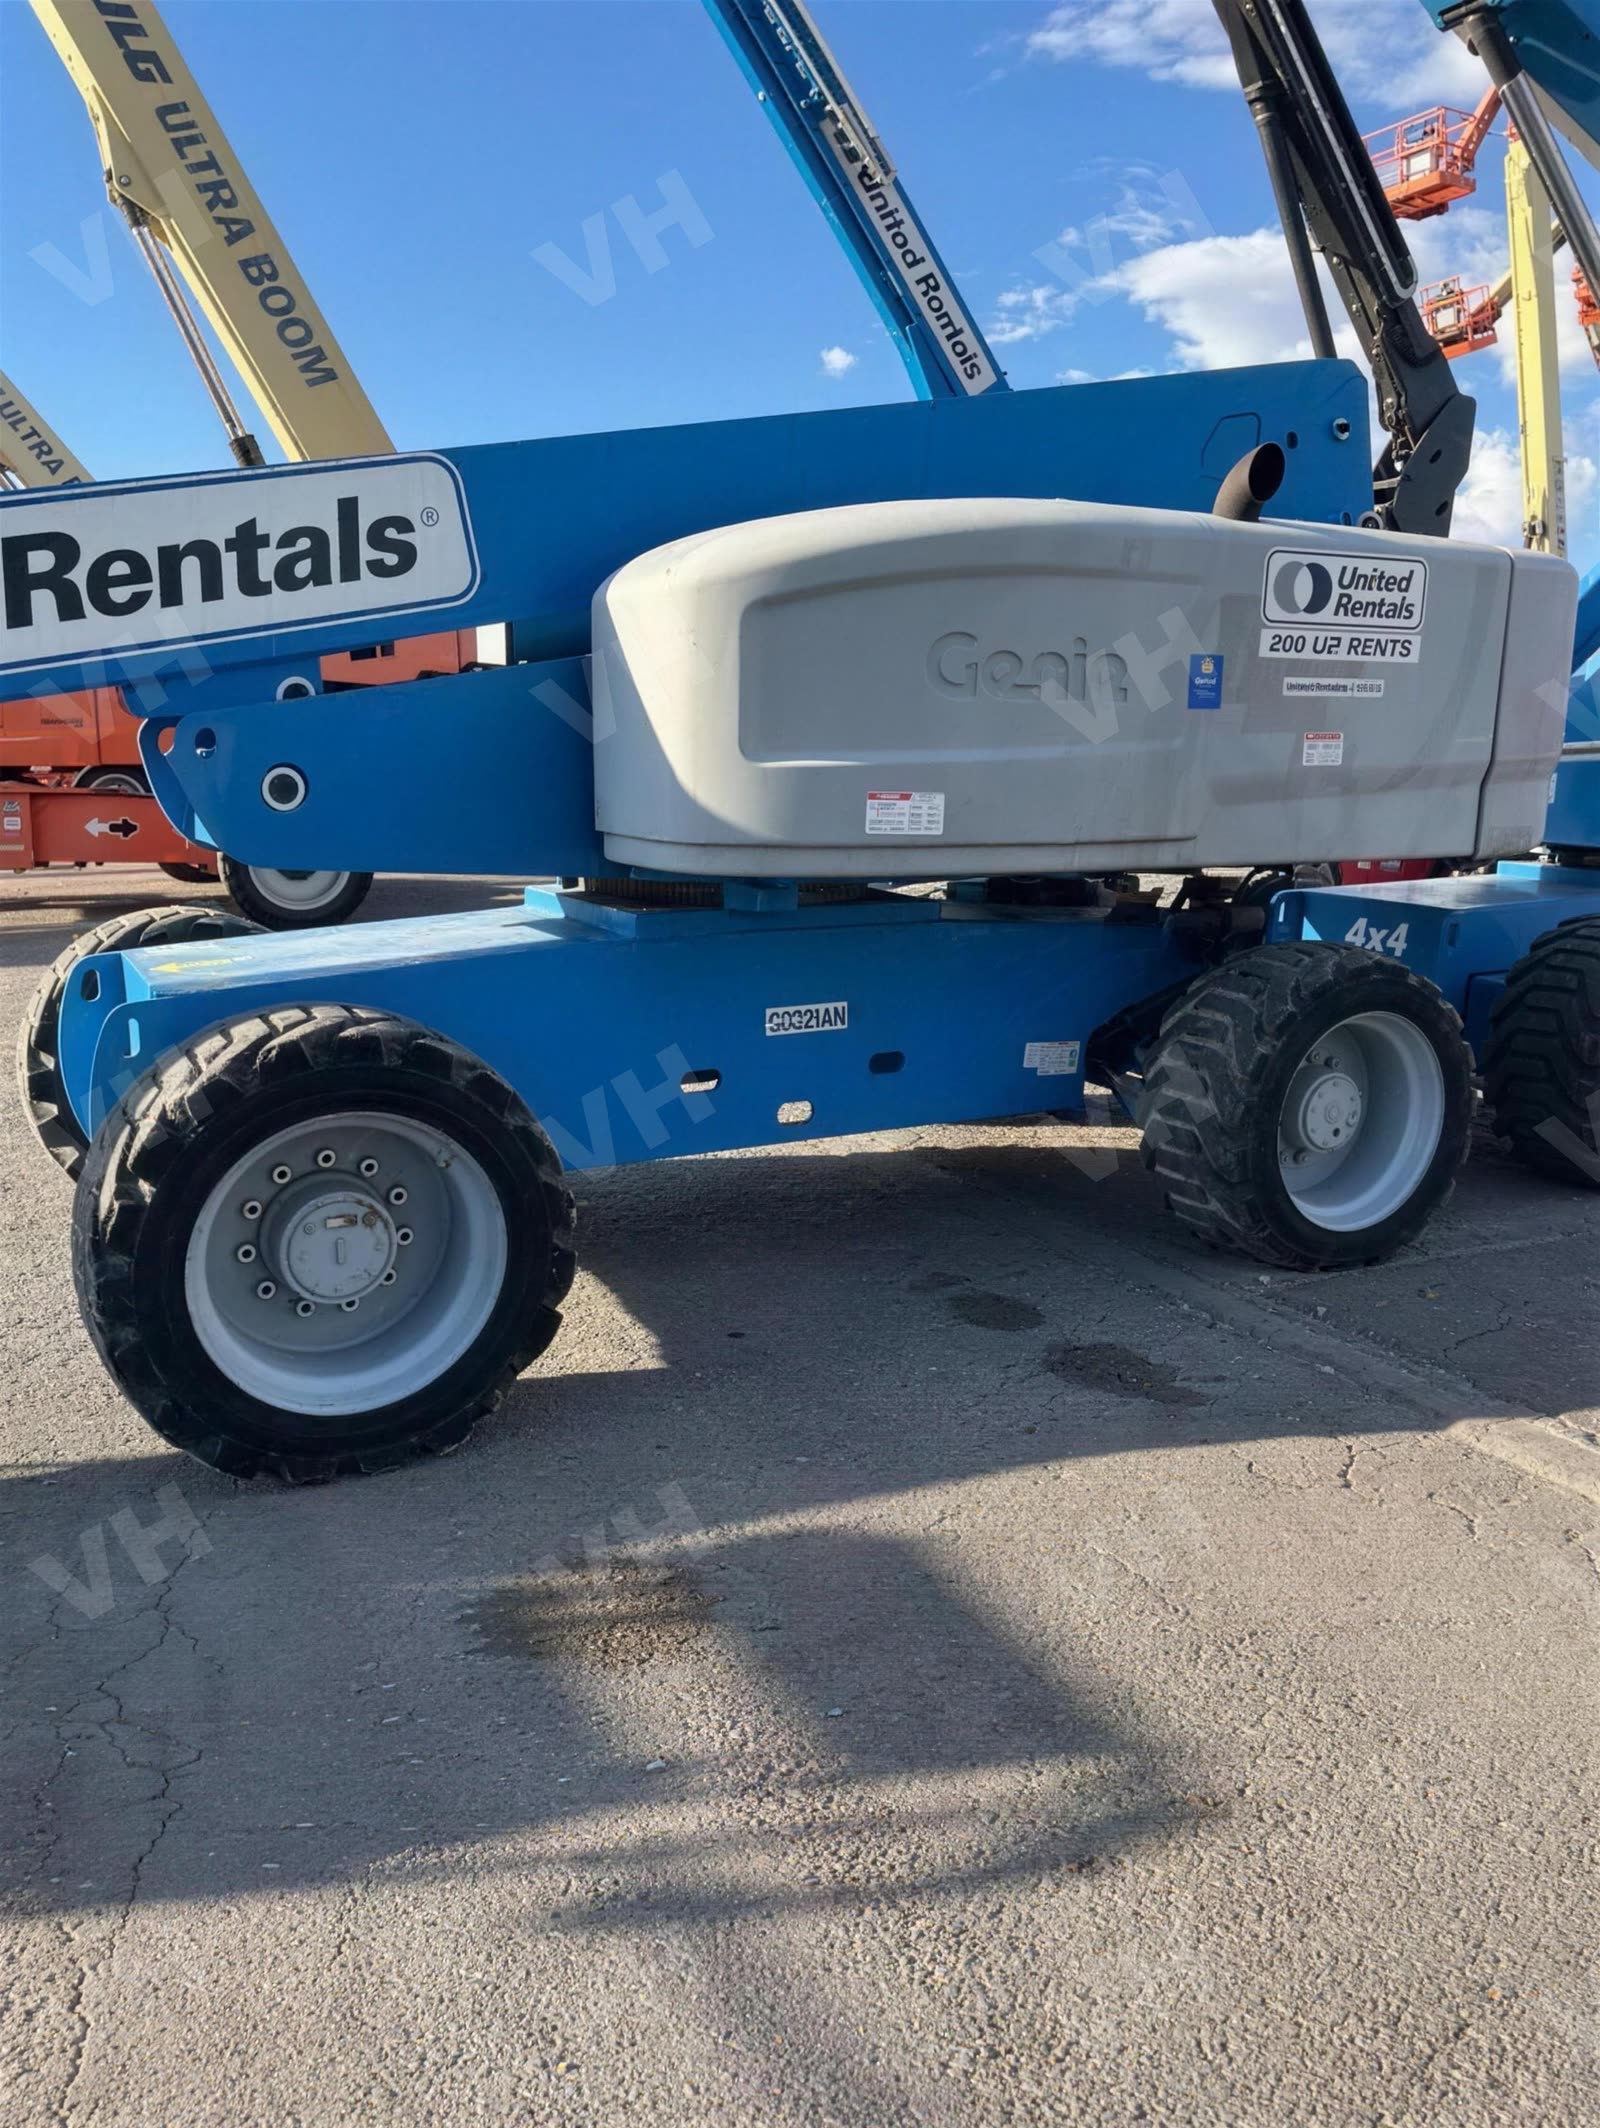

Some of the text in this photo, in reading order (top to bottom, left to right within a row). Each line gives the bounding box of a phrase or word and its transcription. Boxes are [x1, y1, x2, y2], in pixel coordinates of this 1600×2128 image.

[155, 101, 256, 247] ULTRA
[238, 254, 338, 388] BOOM
[0, 400, 65, 476] ULTRA
[1, 496, 418, 630] Rentals
[1338, 566, 1415, 593] United
[1333, 593, 1415, 620] Rentals
[1269, 634, 1307, 653] 200
[1347, 638, 1413, 658] RENTS
[1344, 917, 1410, 956] 4x4
